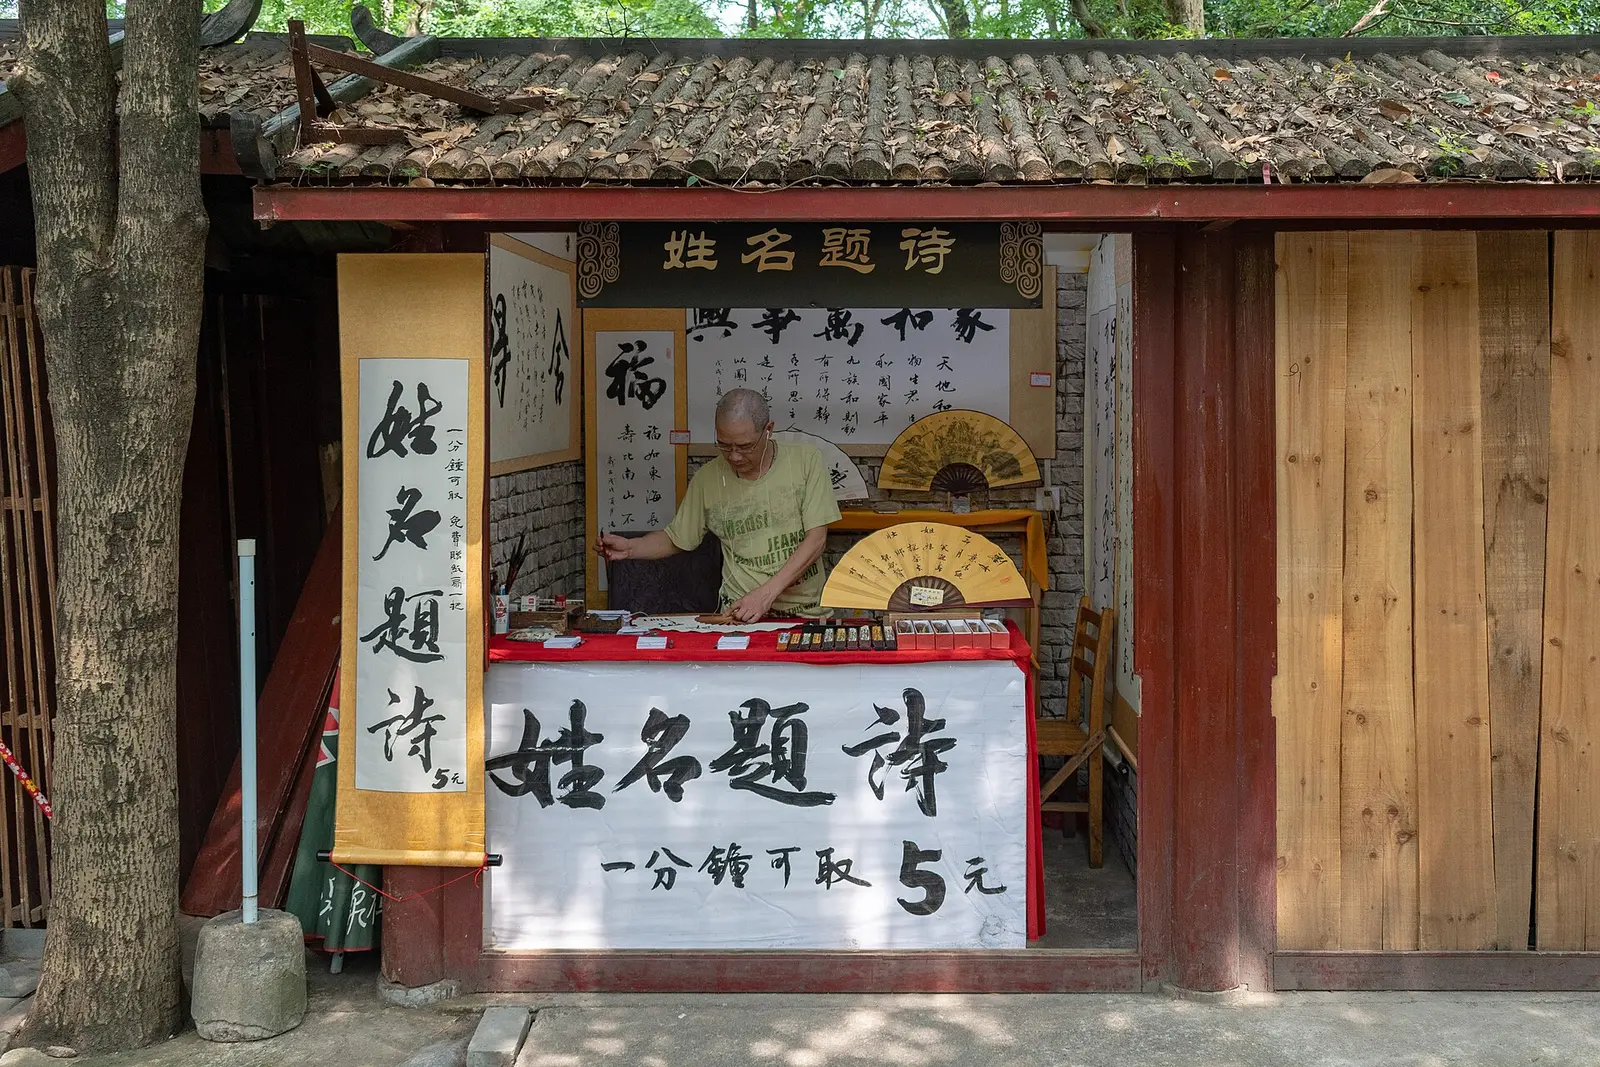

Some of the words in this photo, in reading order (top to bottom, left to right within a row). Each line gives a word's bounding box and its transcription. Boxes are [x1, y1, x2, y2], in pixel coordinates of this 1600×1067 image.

[663, 227, 956, 274] 姓名题诗
[605, 340, 667, 410] 福
[432, 768, 464, 790] 5元
[897, 840, 1007, 916] 5元
